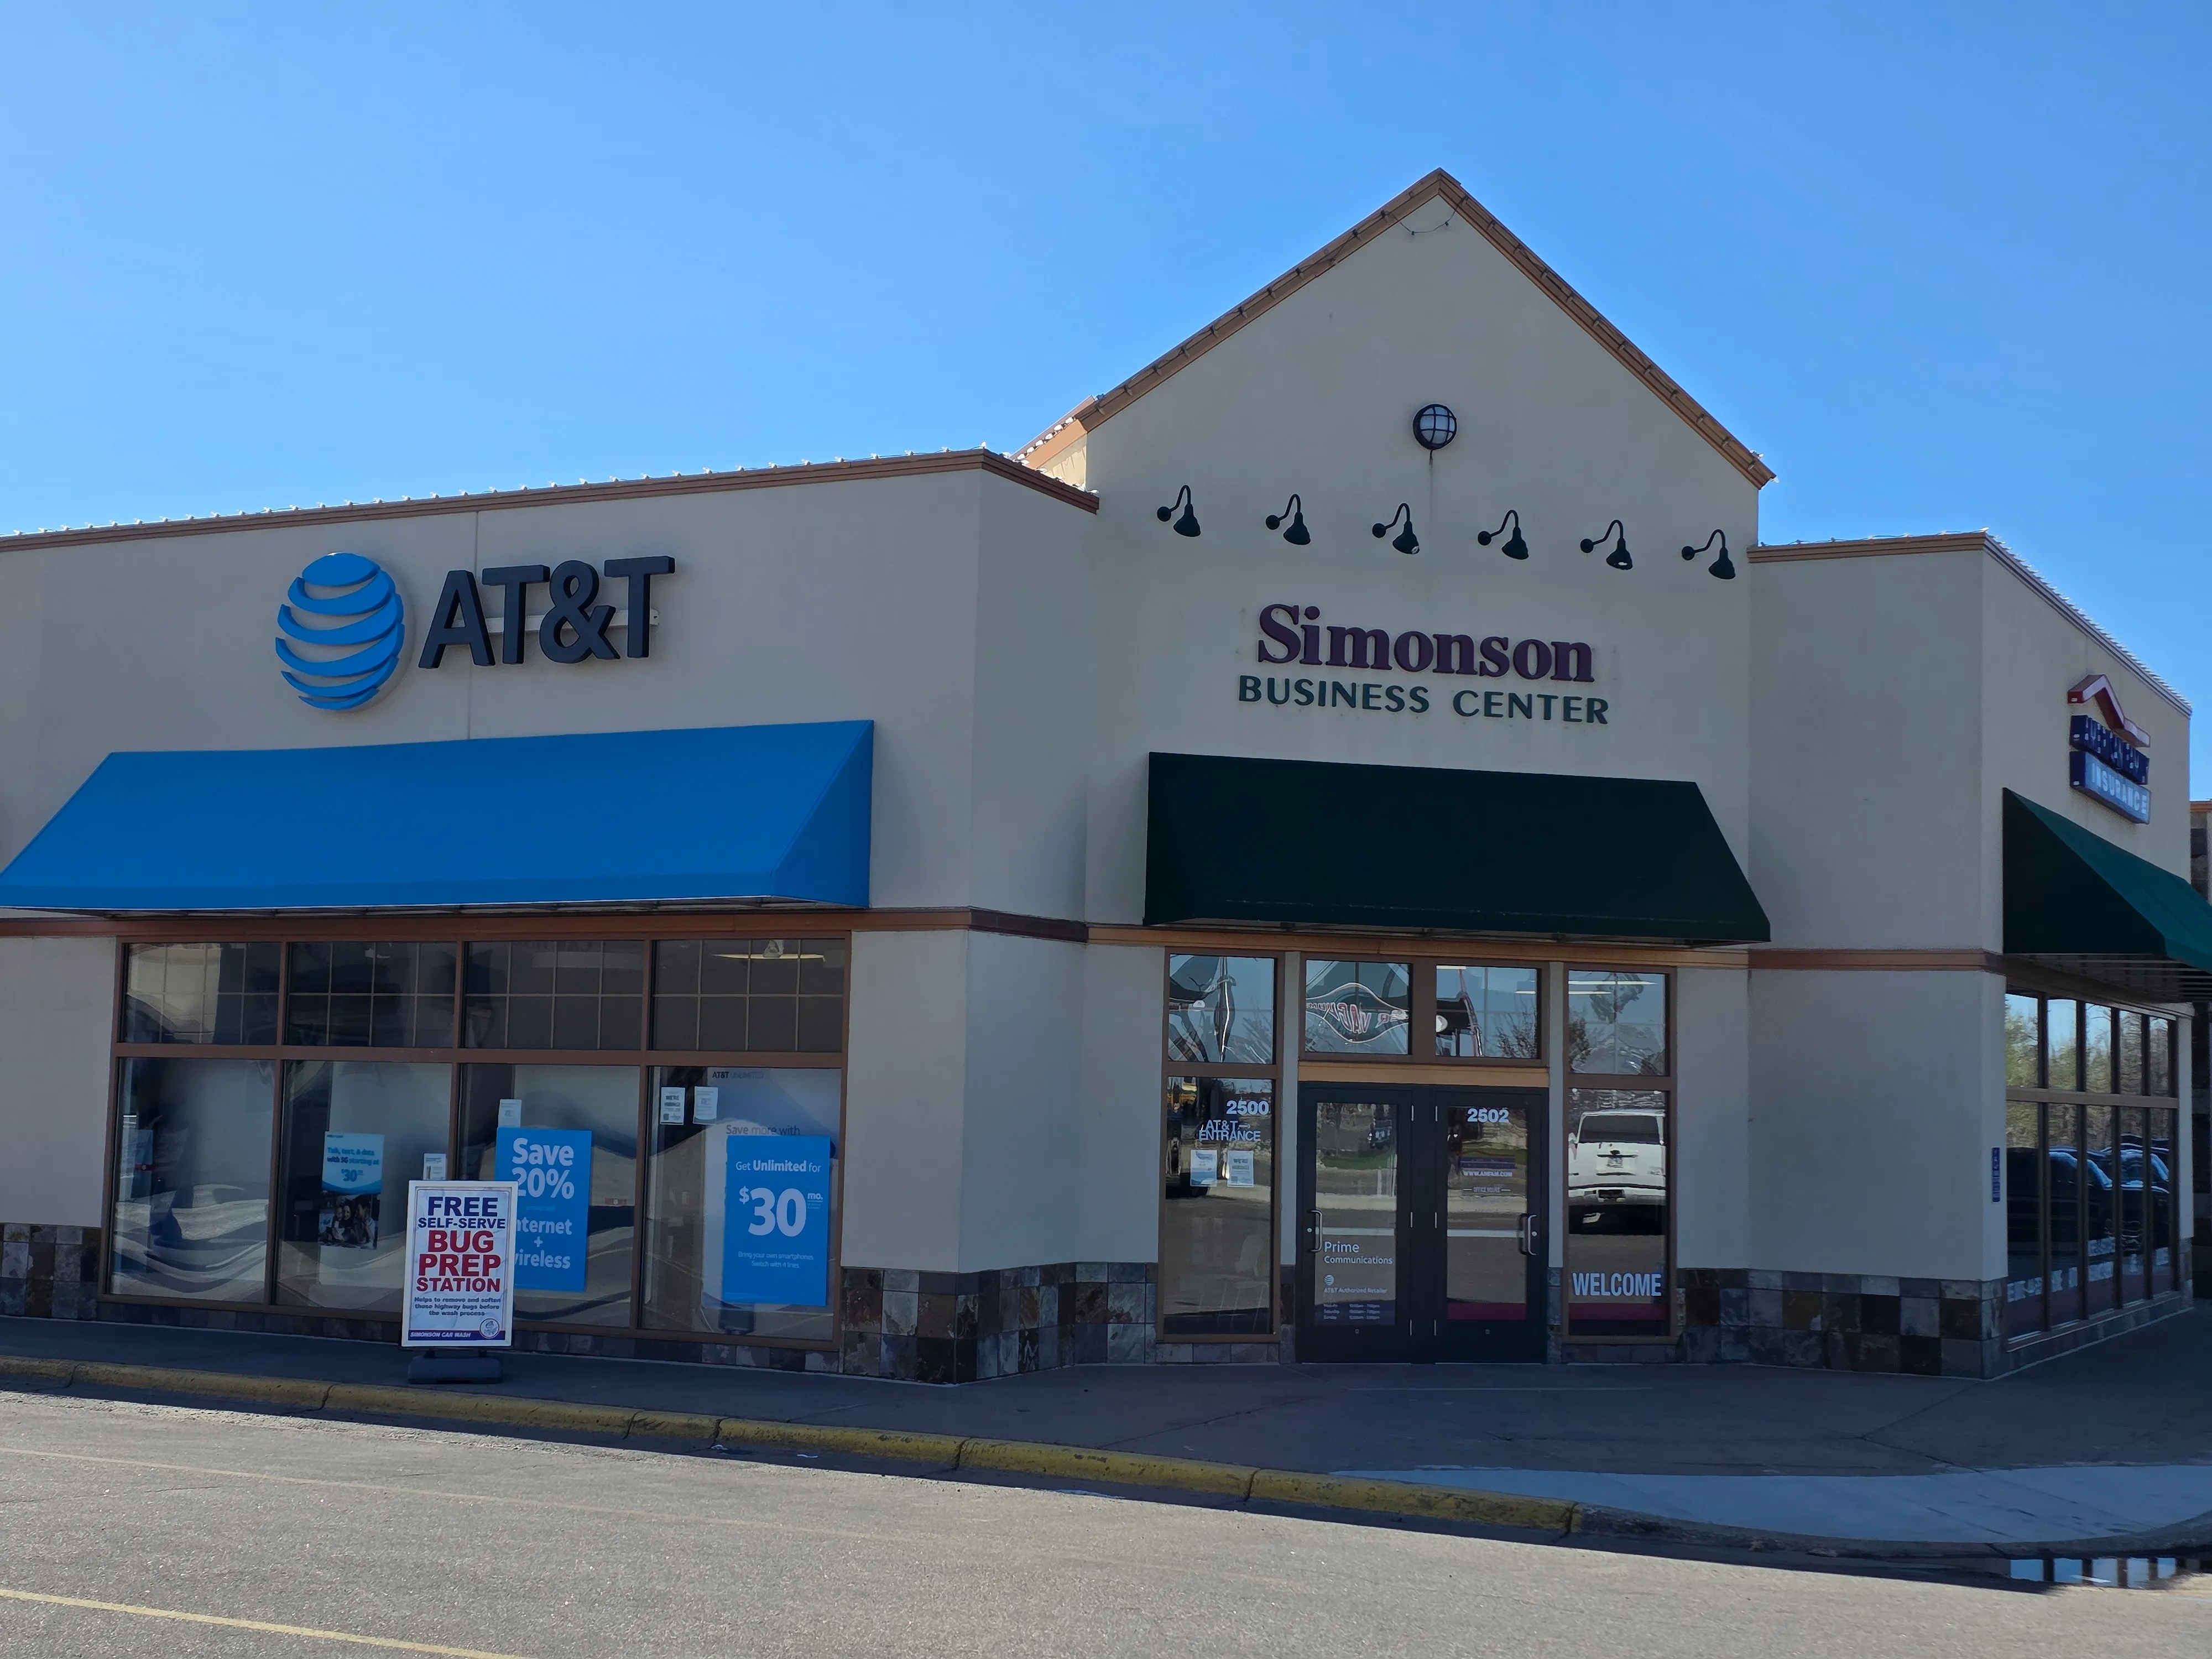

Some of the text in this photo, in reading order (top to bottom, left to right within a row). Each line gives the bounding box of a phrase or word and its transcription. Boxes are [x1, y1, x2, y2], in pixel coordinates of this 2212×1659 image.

[419, 556, 675, 669] AT&T
[1258, 603, 1595, 682] Simonson
[1239, 675, 1609, 724] BUSINESS CENTER
[1226, 1100, 1269, 1115] 2500
[1467, 1108, 1509, 1123] 2502
[726, 1125, 800, 1135] Save more with
[1206, 1119, 1238, 1131] AT&T
[1198, 1130, 1261, 1142] ENTRANCE
[512, 1138, 574, 1166] Save
[735, 1160, 821, 1172] Get Unlimited for
[512, 1167, 575, 1199] 20%
[427, 1197, 498, 1217] FREE
[418, 1218, 505, 1229] SELF-SERVE
[515, 1217, 572, 1235] nternet
[428, 1230, 494, 1253] BUG
[1324, 1241, 1359, 1253] Prime
[738, 1251, 752, 1259] Bring
[1324, 1256, 1393, 1264] Communications
[419, 1254, 501, 1276] PREP
[416, 1278, 500, 1292] STATION
[1572, 1272, 1662, 1296] WELCOME
